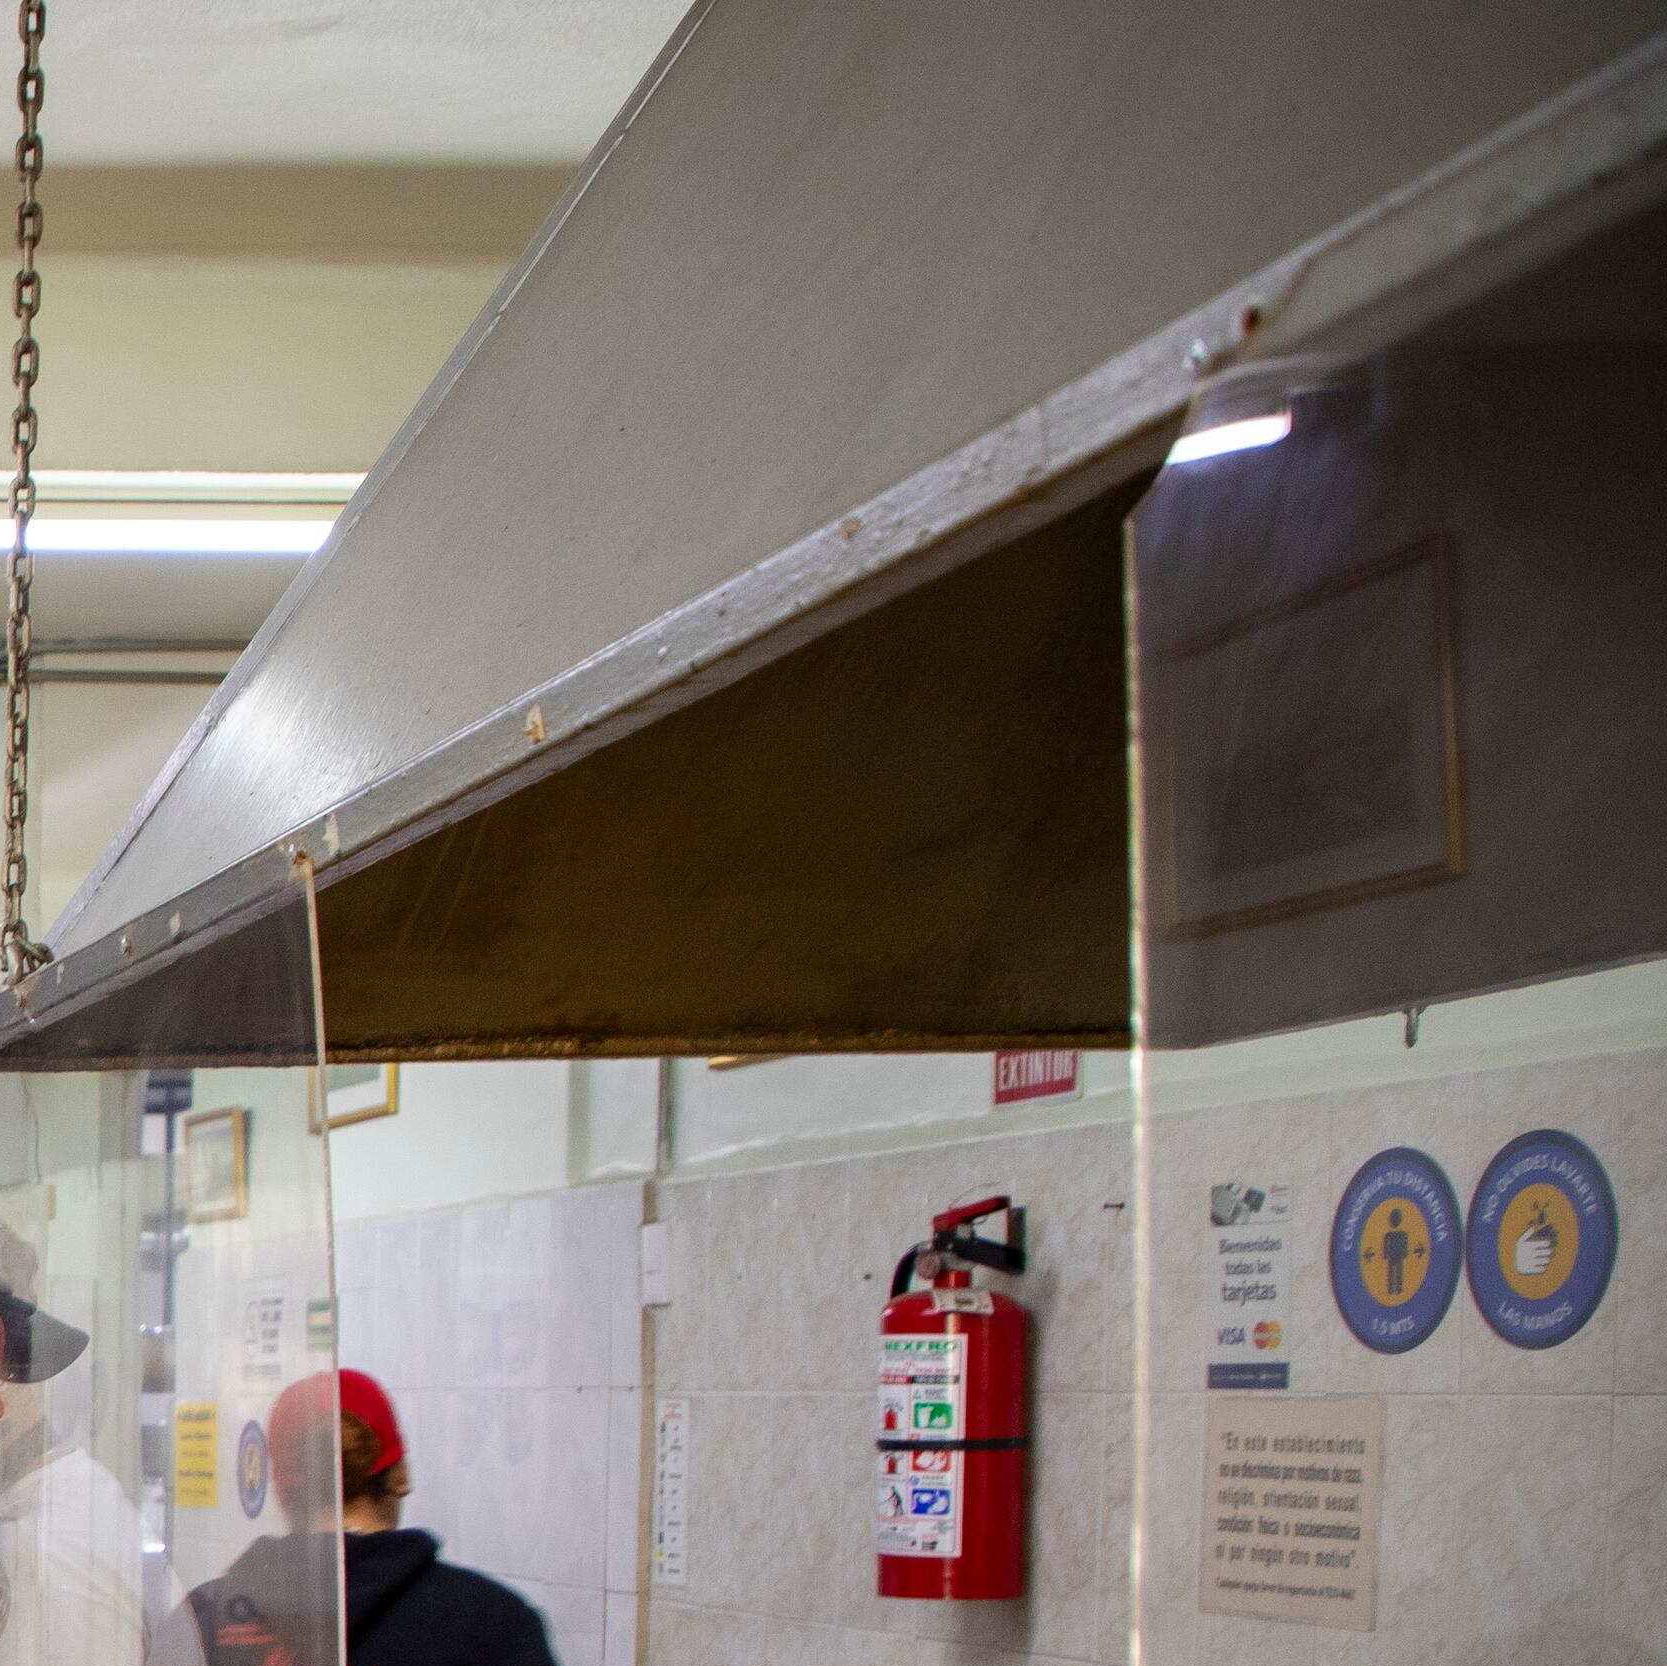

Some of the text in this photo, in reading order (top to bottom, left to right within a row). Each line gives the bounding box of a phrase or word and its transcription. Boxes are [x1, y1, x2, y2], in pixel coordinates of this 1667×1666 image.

[1222, 1281, 1277, 1306] tarjetas
[1498, 1302, 1573, 1331] LAS MANOS
[1218, 1326, 1246, 1344] VISA
[1273, 1434, 1365, 1455] establecimiento
